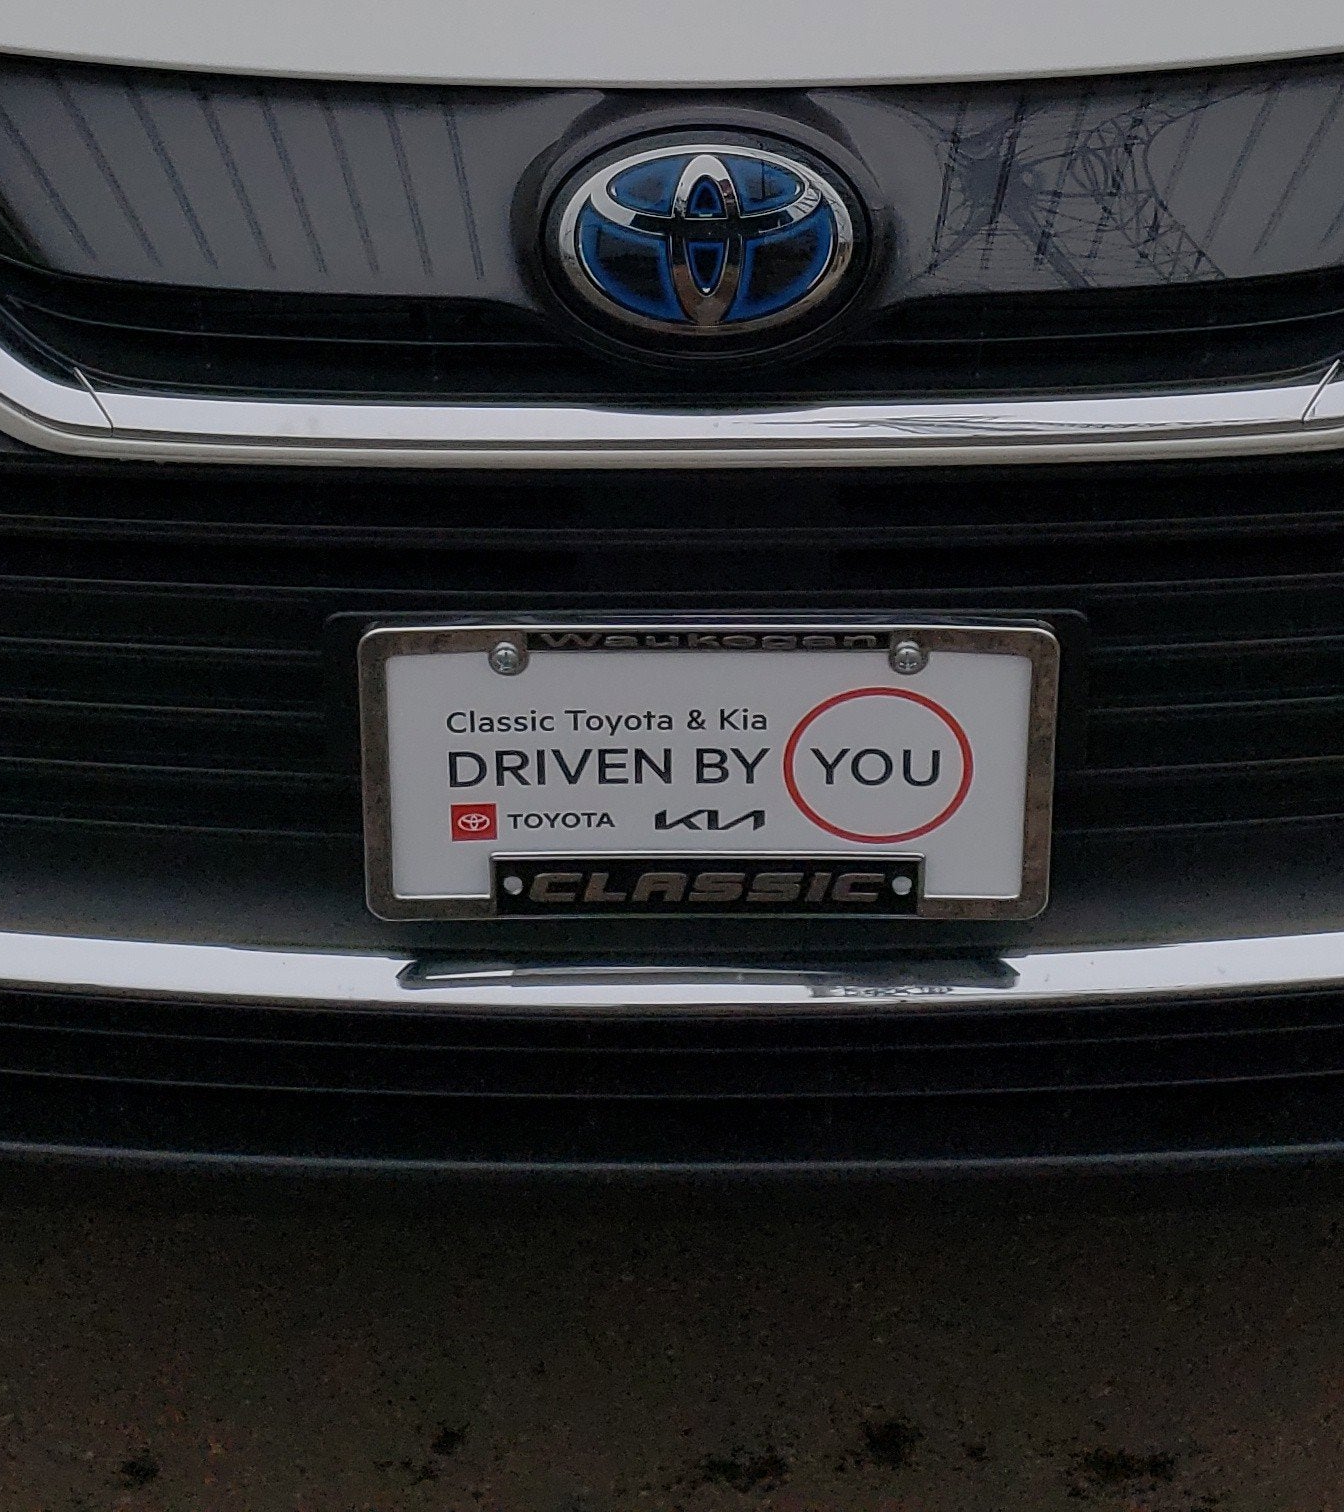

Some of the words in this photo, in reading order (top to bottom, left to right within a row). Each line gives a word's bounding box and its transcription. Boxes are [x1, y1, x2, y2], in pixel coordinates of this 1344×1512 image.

[446, 710, 555, 733] Classic
[564, 709, 674, 736] Toyota
[686, 709, 707, 731] &
[719, 708, 768, 731] Kia
[448, 748, 673, 788] DRIVEN
[695, 747, 771, 785] BY
[809, 747, 941, 787] YOU
[507, 812, 616, 830] TOYOTA
[528, 871, 887, 903] CLASSIC
